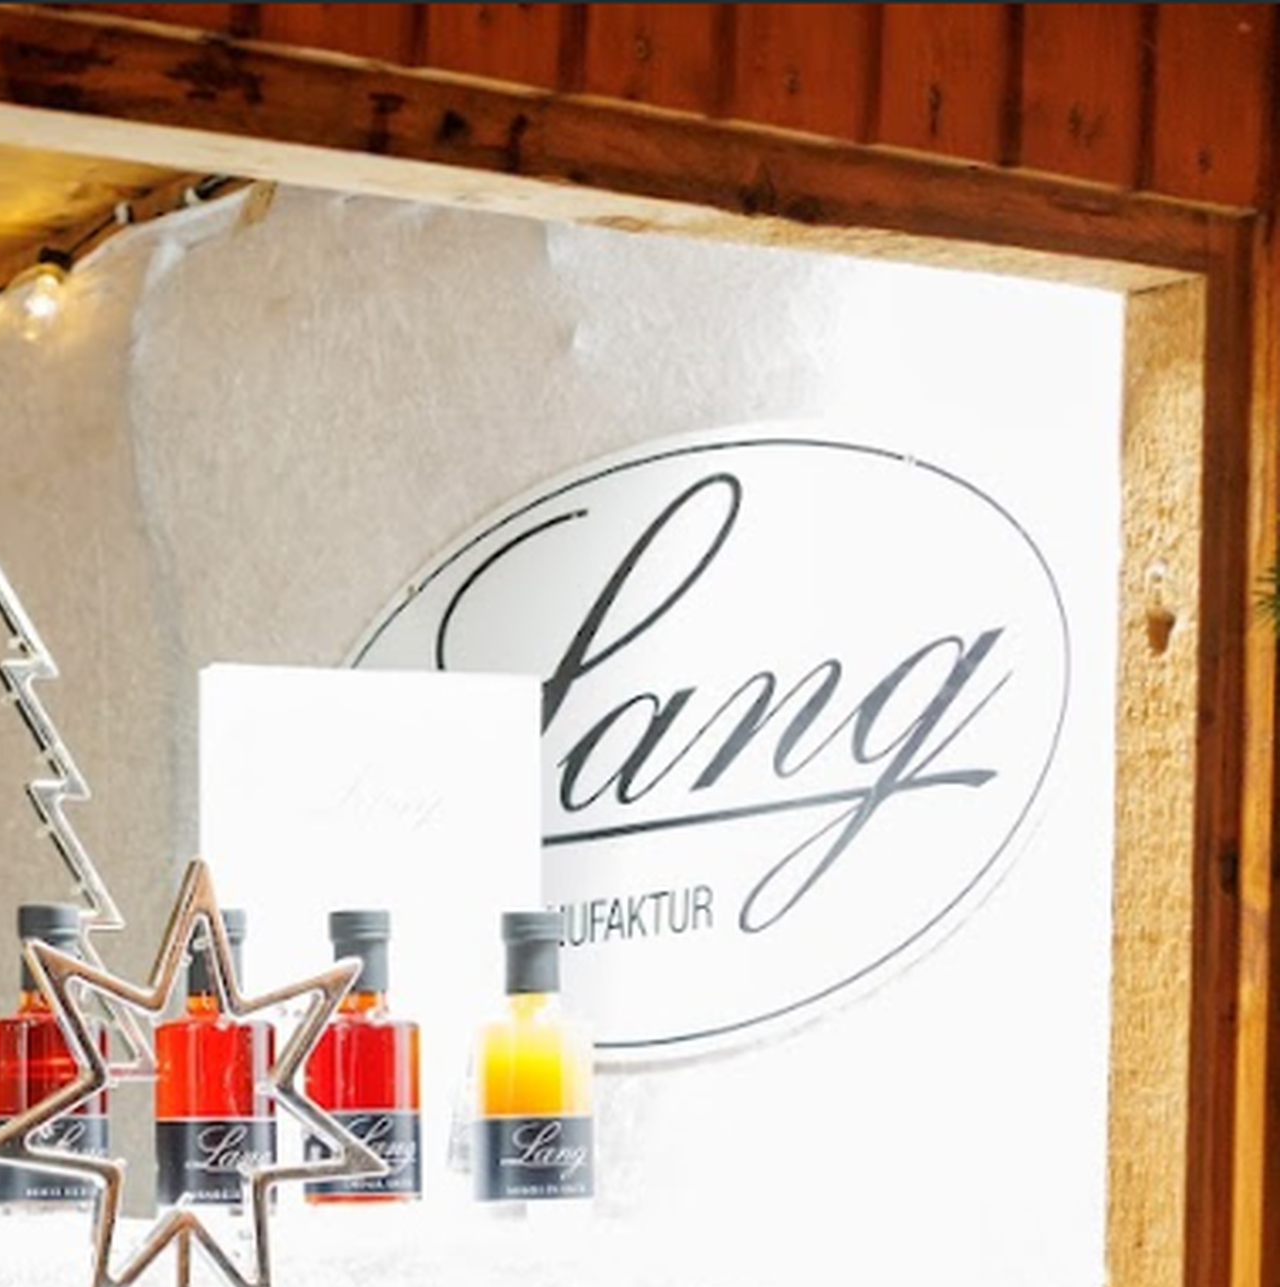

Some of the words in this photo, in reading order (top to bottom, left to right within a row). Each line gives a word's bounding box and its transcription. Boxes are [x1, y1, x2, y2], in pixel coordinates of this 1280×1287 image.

[437, 473, 1013, 935] Lang
[552, 884, 713, 946] UFAKTUR
[499, 1120, 589, 1182] Lang
